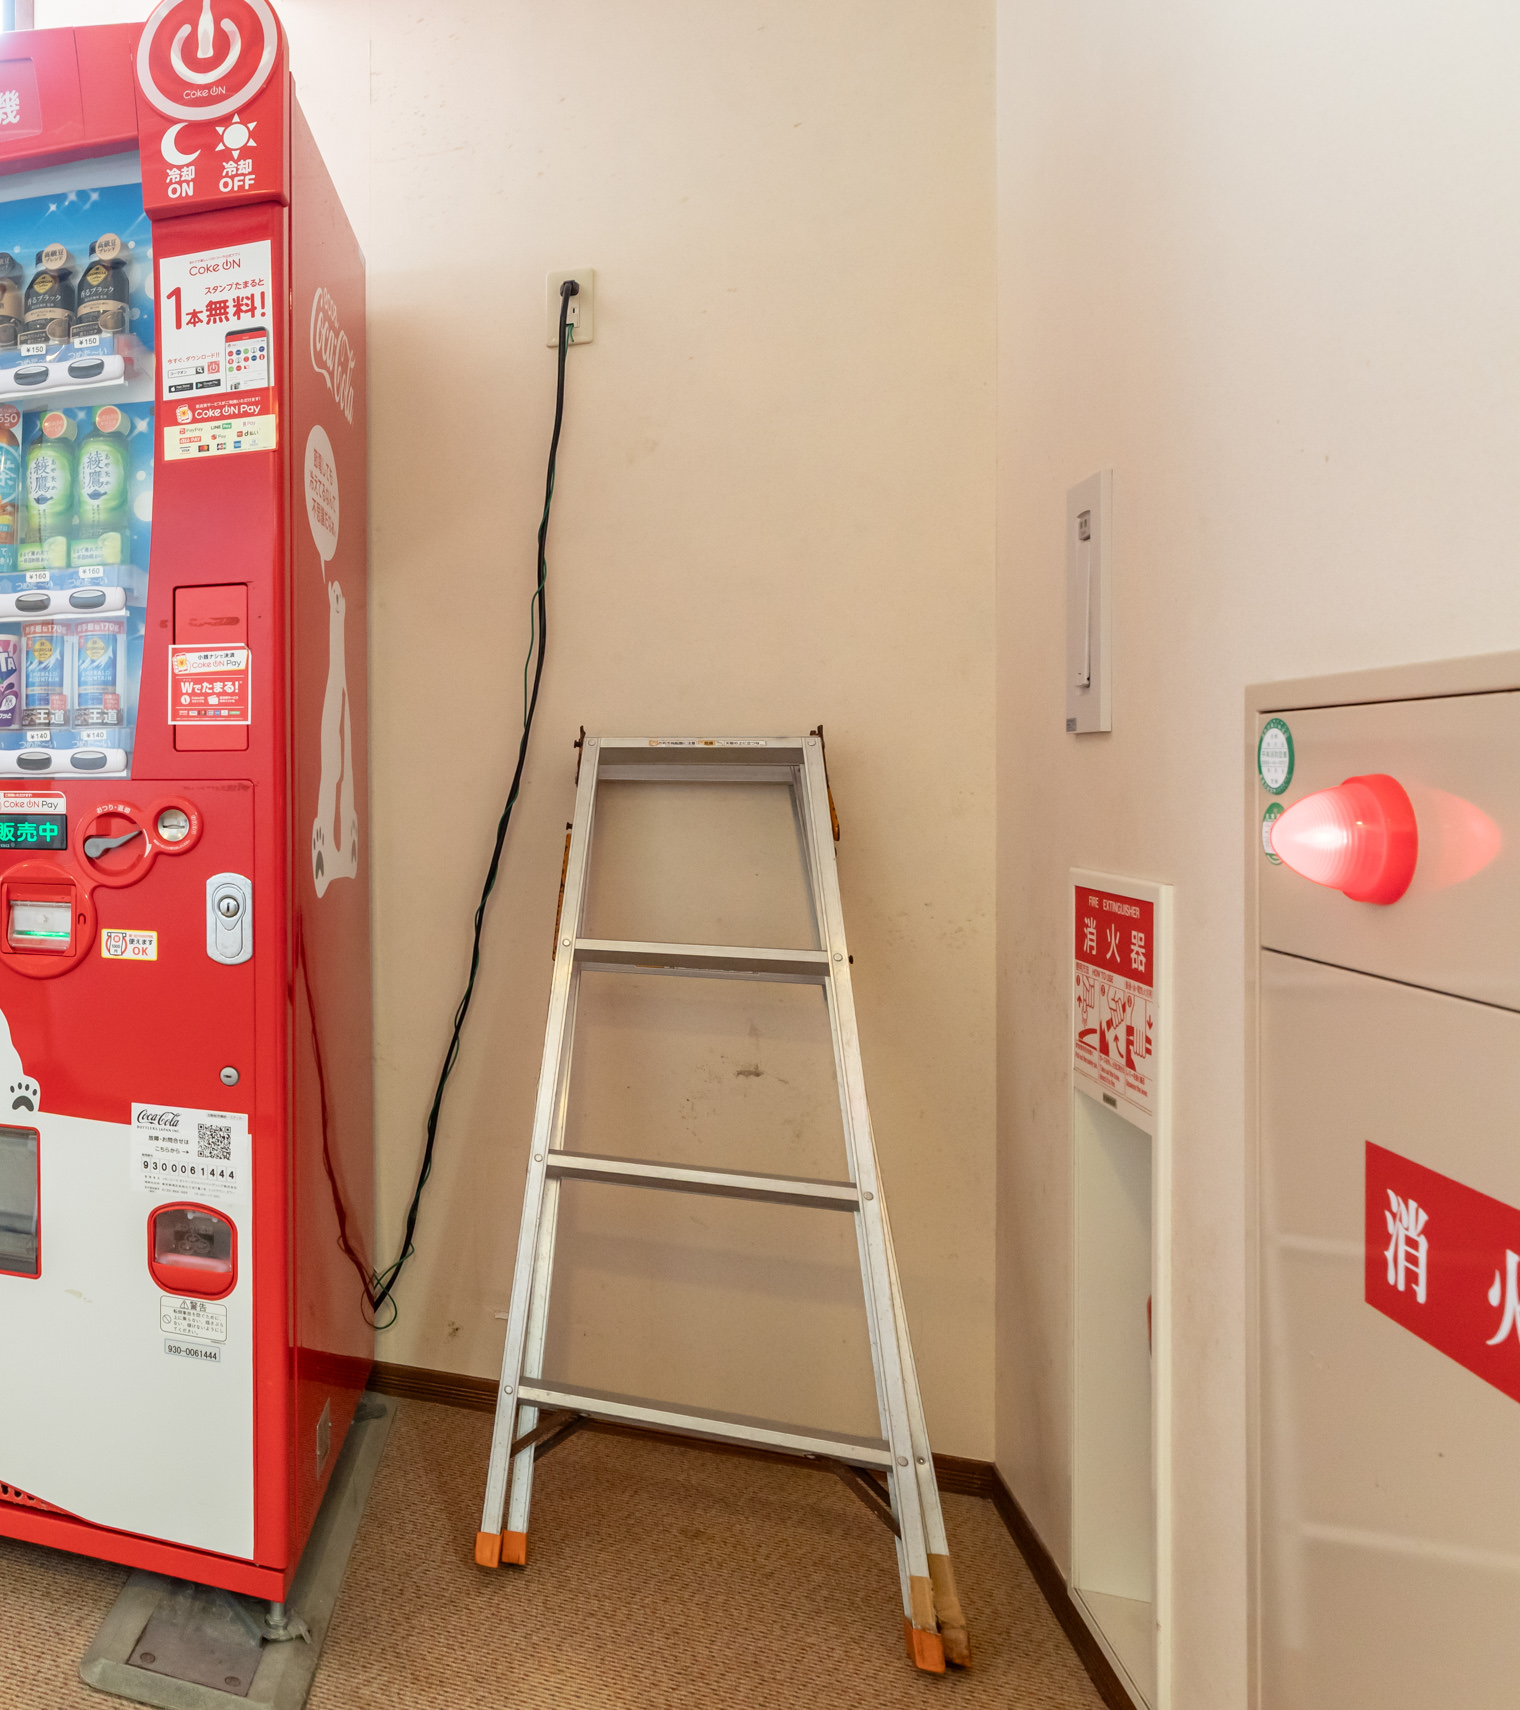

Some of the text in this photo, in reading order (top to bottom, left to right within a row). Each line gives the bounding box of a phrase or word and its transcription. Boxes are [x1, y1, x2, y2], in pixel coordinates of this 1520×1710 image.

[184, 87, 208, 99] Coke
[166, 165, 195, 183] 冷却
[222, 159, 252, 176] 冷却
[167, 182, 194, 198] ON
[219, 174, 255, 192] OFF
[189, 263, 220, 276] Coke
[204, 278, 265, 295] スタンプたまると
[166, 286, 266, 330] 1本無料!
[310, 287, 356, 426] Coca-Cola
[195, 409, 221, 419] Coke
[240, 404, 261, 415] Pay
[192, 661, 212, 669] Coke
[226, 659, 242, 667] Pay
[181, 681, 239, 693] Wでたまる!
[36, 709, 65, 724] 王道
[3, 800, 25, 808] Coke
[41, 800, 59, 810] Pay
[1088, 895, 1140, 919] FIRE EXTINGUISHER
[132, 946, 149, 956] OK
[1083, 916, 1147, 973] 消火器
[136, 1108, 182, 1128] Coca-Cola
[155, 1146, 180, 1154] こちらから
[167, 1345, 218, 1361] 930-0061444
